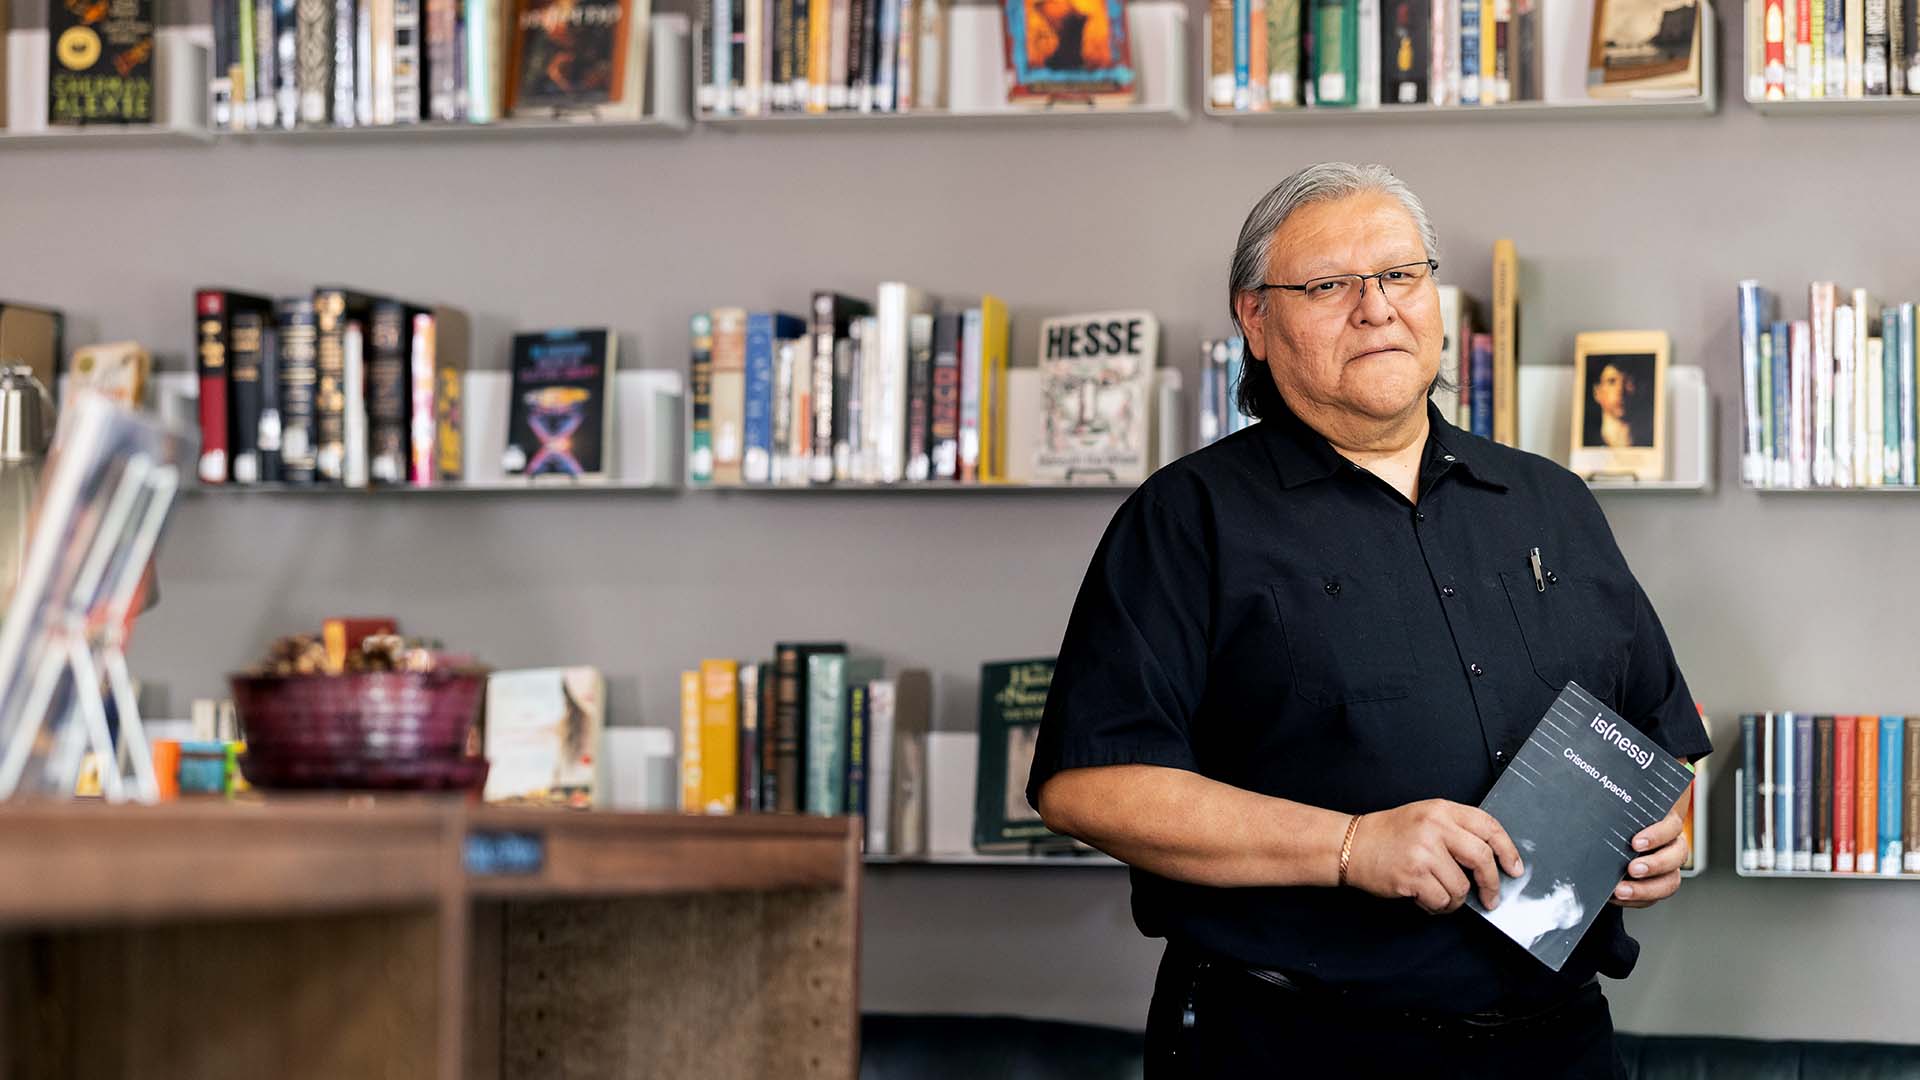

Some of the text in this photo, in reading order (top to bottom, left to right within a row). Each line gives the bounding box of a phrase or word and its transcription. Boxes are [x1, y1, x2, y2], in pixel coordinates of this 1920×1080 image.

[1046, 319, 1142, 360] HESSE
[1590, 712, 1655, 770] is(ness)
[1563, 747, 1633, 804] Crisosto Apache
